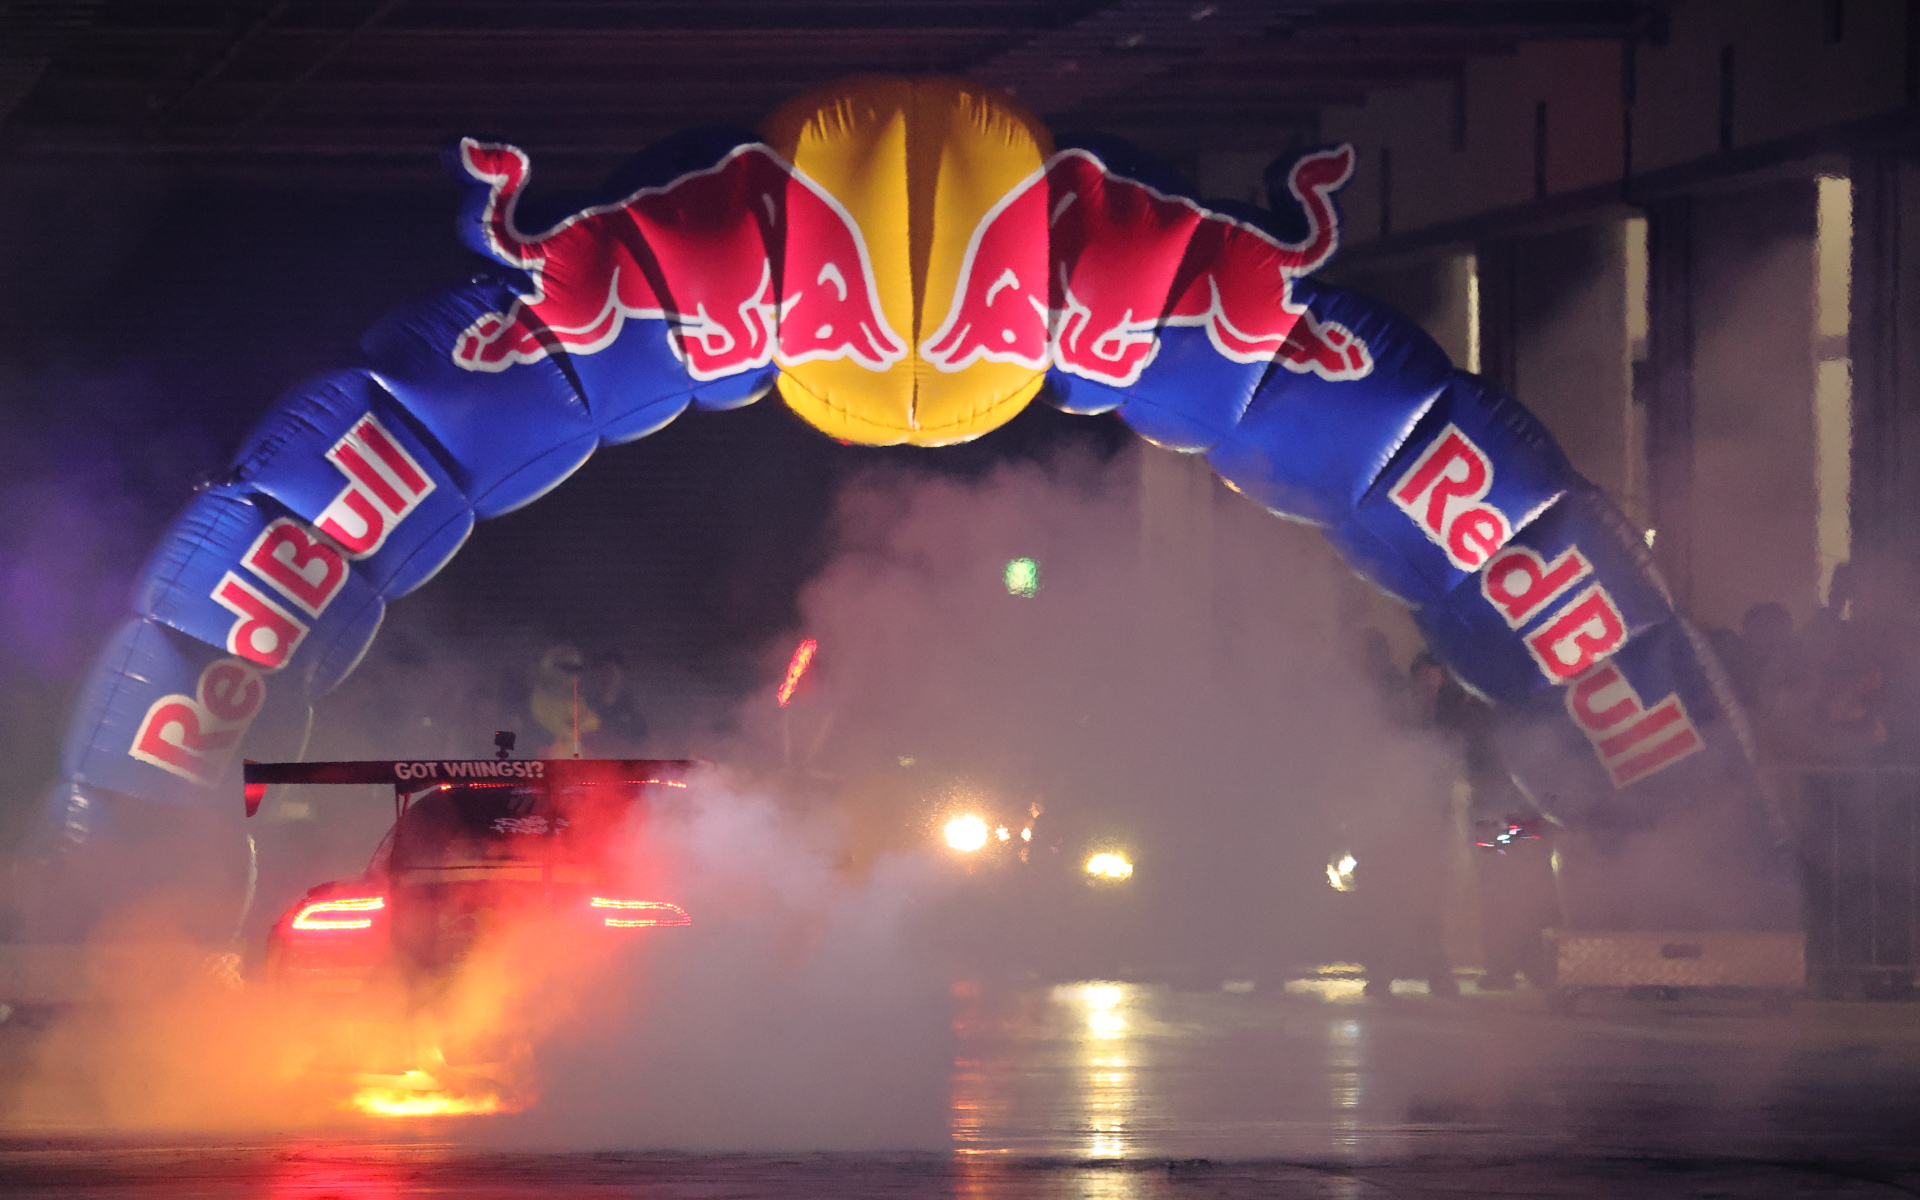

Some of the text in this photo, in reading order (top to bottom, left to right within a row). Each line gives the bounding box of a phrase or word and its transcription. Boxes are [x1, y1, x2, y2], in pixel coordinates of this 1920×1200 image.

[130, 411, 437, 785] Red Bull
[394, 761, 545, 780] GOT WIINGS!?
[1387, 422, 1705, 789] Red Bull
